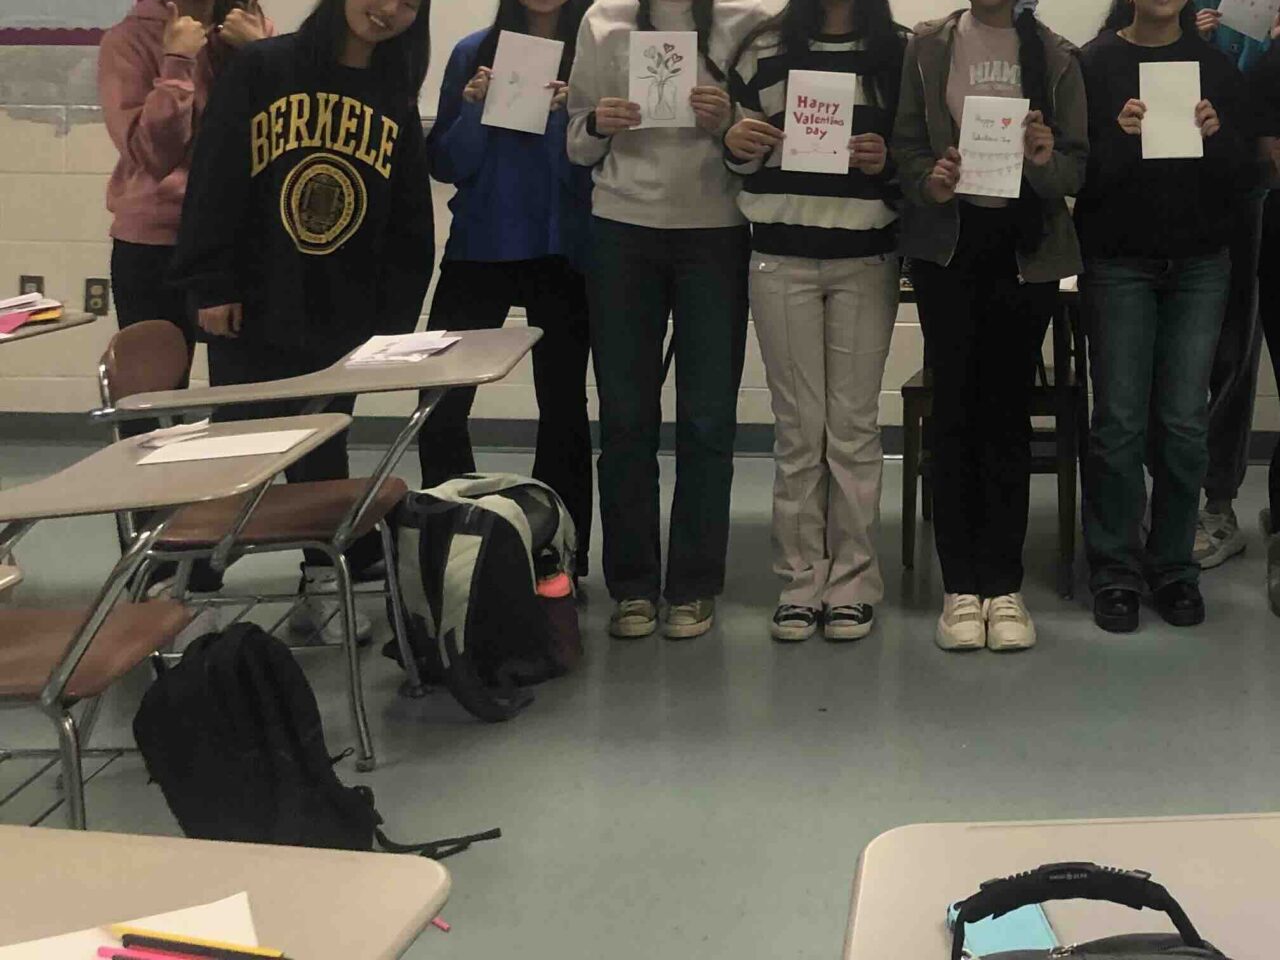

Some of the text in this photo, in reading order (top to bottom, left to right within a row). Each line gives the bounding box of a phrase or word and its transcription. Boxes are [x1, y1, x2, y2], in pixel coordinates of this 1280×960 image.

[969, 60, 1022, 86] MIAM
[797, 95, 840, 115] Happy
[806, 126, 827, 140] Day
